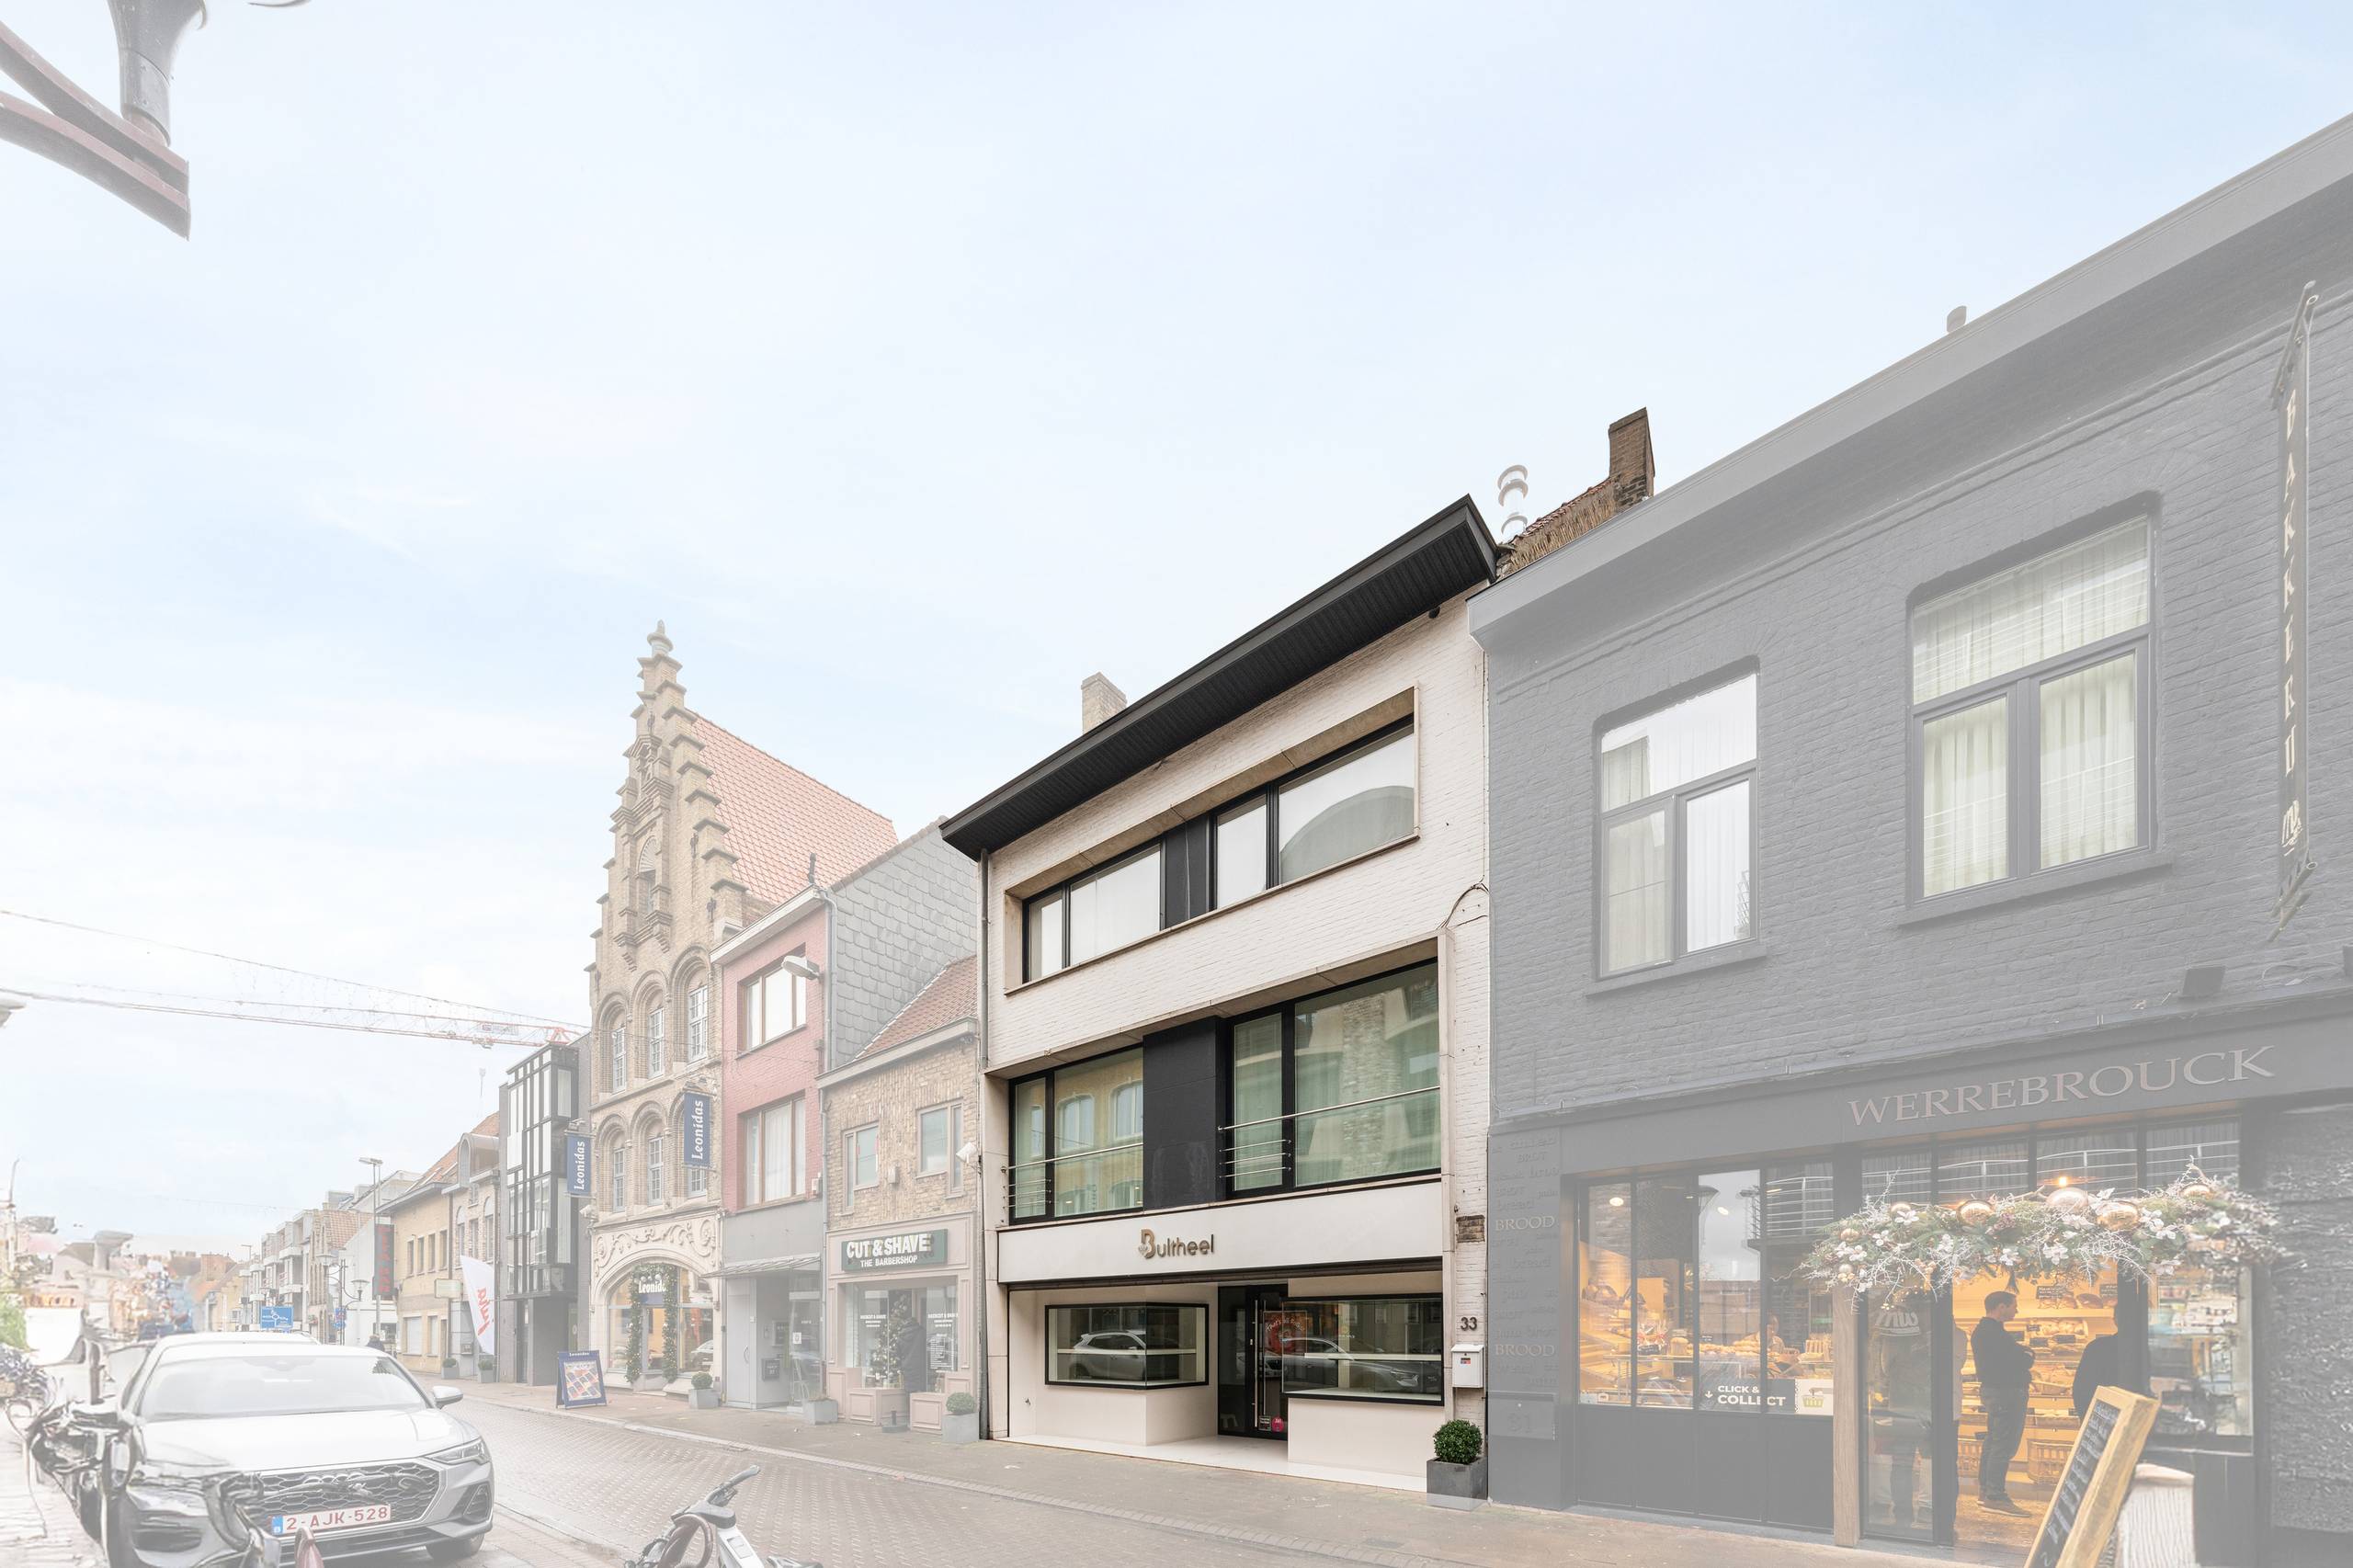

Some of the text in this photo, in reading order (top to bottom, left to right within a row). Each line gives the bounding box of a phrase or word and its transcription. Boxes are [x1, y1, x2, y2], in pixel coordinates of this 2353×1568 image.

[1847, 1045, 2275, 1127] WERREBROUCK
[691, 1099, 704, 1160] Leonidas
[574, 1140, 585, 1191] Leonidas
[1495, 1215, 1555, 1231] BROOD
[847, 1233, 931, 1258] CUT & SHAVE
[1139, 1228, 1214, 1259] Bultheel
[860, 1255, 918, 1267] THE BARBERSHOP
[1461, 1316, 1478, 1332] 33
[1495, 1344, 1555, 1357] BROOD
[1718, 1385, 1748, 1393] CLICK
[287, 1506, 388, 1530] 2-AJK-528
